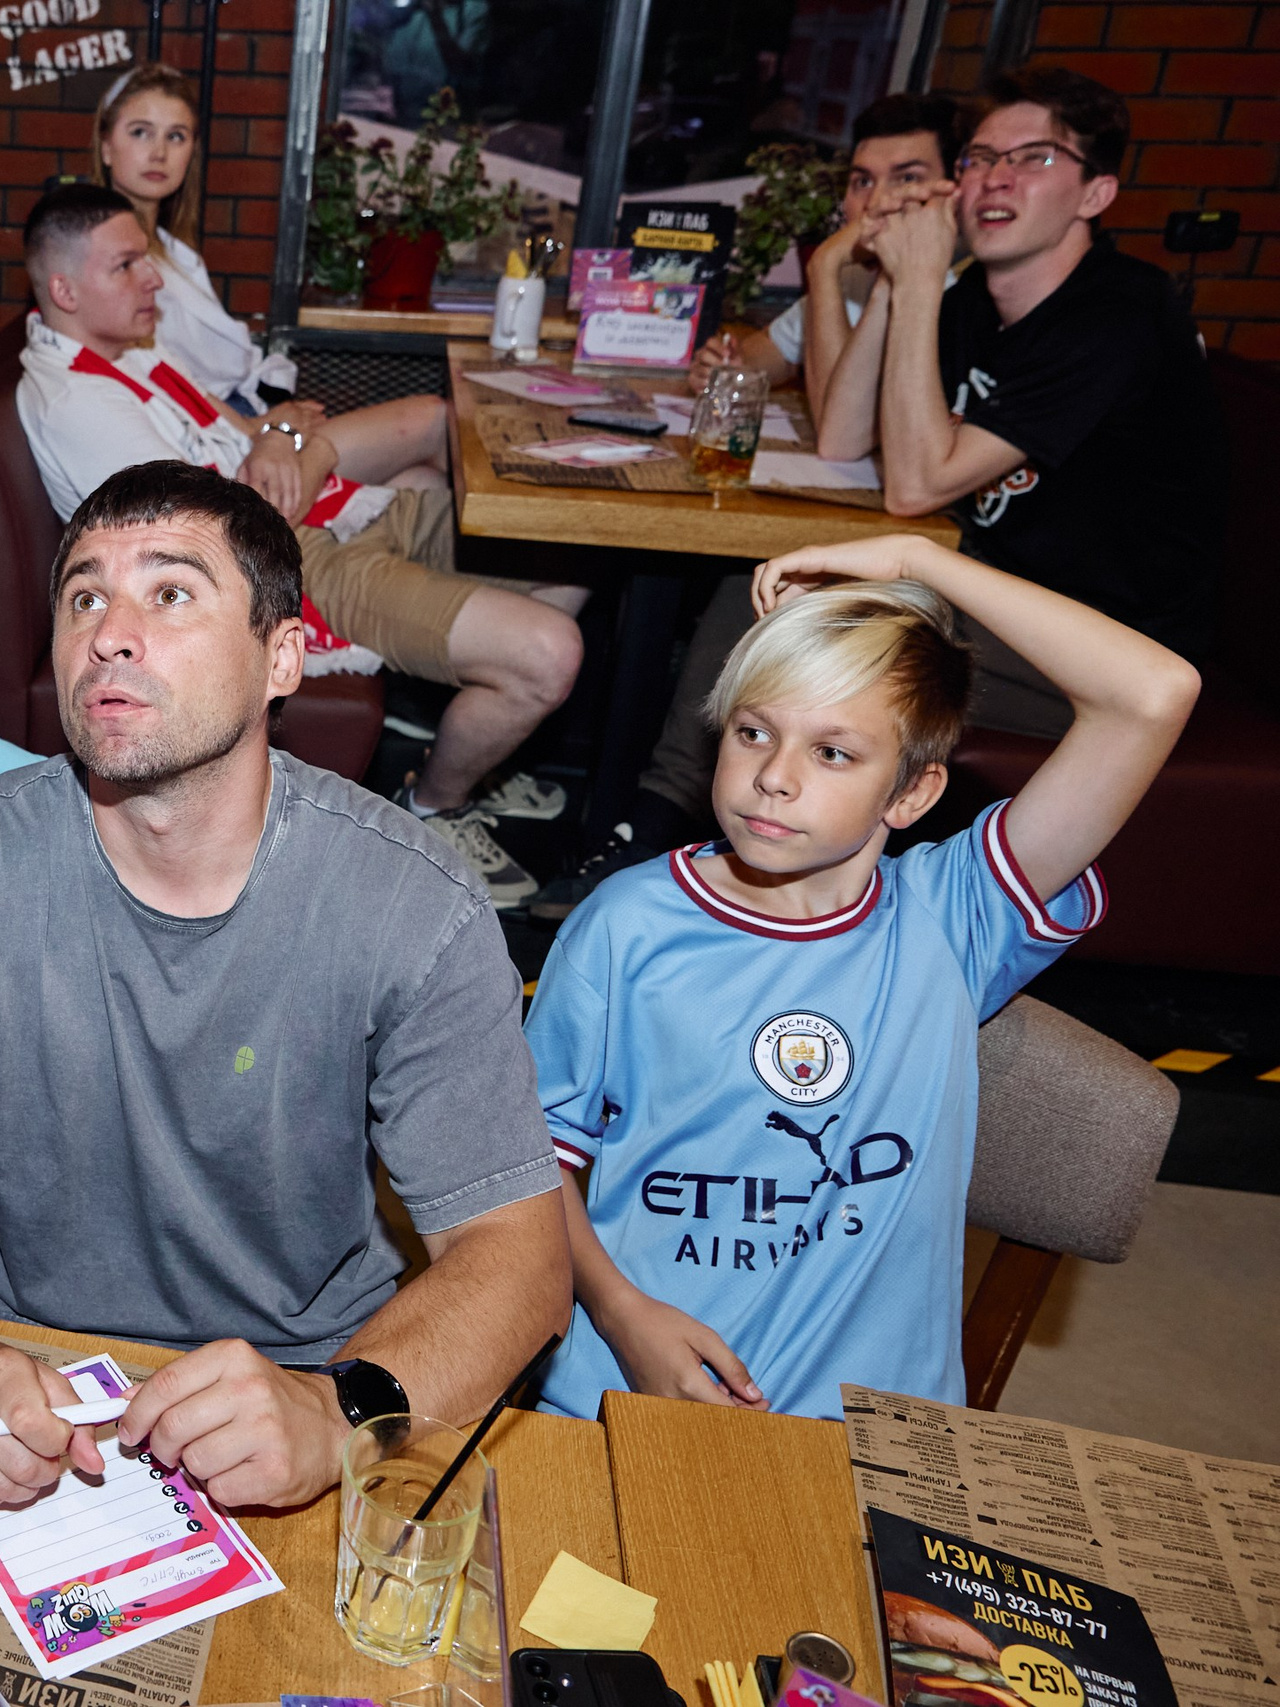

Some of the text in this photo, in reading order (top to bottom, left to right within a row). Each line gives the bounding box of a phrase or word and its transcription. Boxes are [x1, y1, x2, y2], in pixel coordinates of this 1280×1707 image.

[7, 29, 133, 91] LAGER
[647, 209, 674, 228] ИЗИ
[765, 1018, 840, 1047] MANCHESTER
[790, 1087, 818, 1097] CITY
[909, 1417, 938, 1430] СОУСЫ
[909, 1471, 950, 1487] ГАРНИРЫ
[186, 1548, 214, 1562] КОМАНДА
[923, 1535, 1093, 1612] ИЗИ ПАБ
[50, 1584, 90, 1614] QUIZ
[926, 1570, 1107, 1640] +7(495) 323-87-77
[973, 1601, 1074, 1649] ДОСТАВКА
[179, 1644, 199, 1656] САЛАТ
[116, 1658, 145, 1673] ИНДЕЙКИ
[145, 1667, 153, 1676] ИЗ
[1209, 1663, 1259, 1683] АССОРТИ
[131, 1670, 164, 1688] КОПЧЁНЫМ
[154, 1669, 186, 1685] ПАСТРАМИ
[1008, 1662, 1078, 1697] -25%
[1074, 1664, 1137, 1695] НА ПЕРВЫЙ
[16, 1675, 79, 1707] ИЗИ
[138, 1685, 175, 1705] САЛАТЫ
[171, 1681, 190, 1693] САЛАТ
[1084, 1681, 1120, 1702] ЗАКАЗ
[89, 1688, 138, 1707] ФОТО ЗДЕСЬ!
